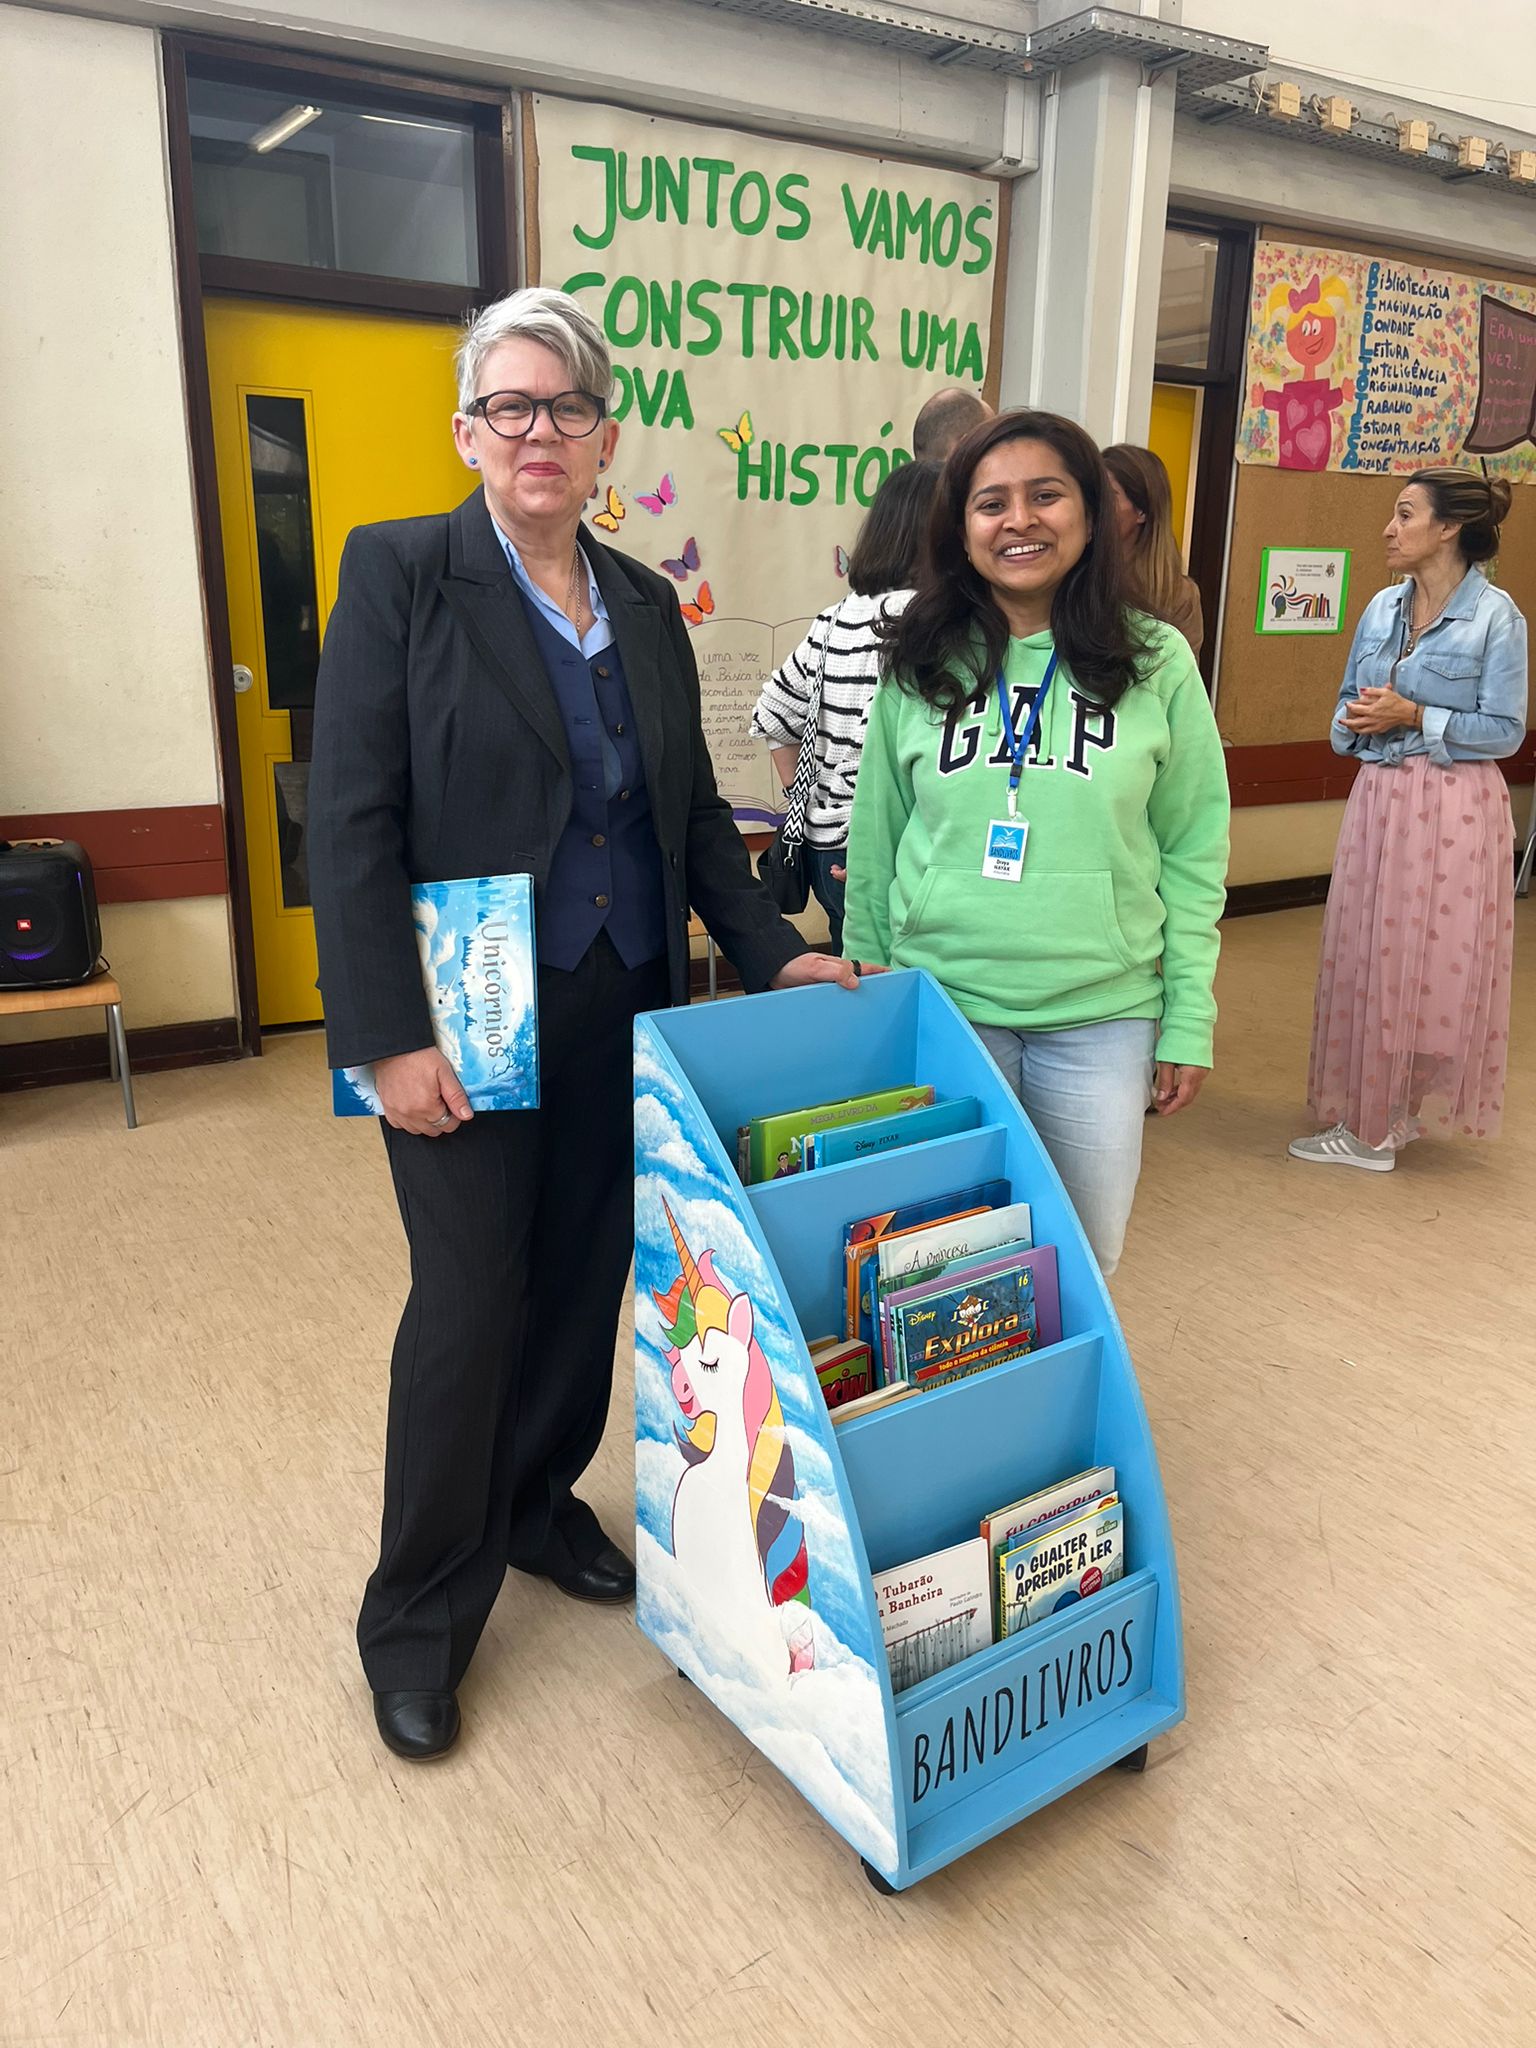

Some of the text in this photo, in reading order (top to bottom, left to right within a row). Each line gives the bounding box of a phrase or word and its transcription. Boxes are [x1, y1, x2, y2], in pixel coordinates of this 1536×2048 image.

[571, 144, 993, 275] JUNTOS VAMOS
[901, 308, 984, 382] UMA
[937, 684, 1118, 781] GAP
[480, 921, 508, 1058] Unicórnios
[1018, 1274, 1029, 1288] 16
[924, 1313, 1019, 1360] Explora
[883, 1575, 933, 1599] Tubarão
[1015, 1533, 1088, 1581] O GUALTER
[1016, 1539, 1112, 1601] APRENDE A LER
[889, 1588, 943, 1614] Banheira
[913, 1619, 1133, 1803] BANDLIVROS
